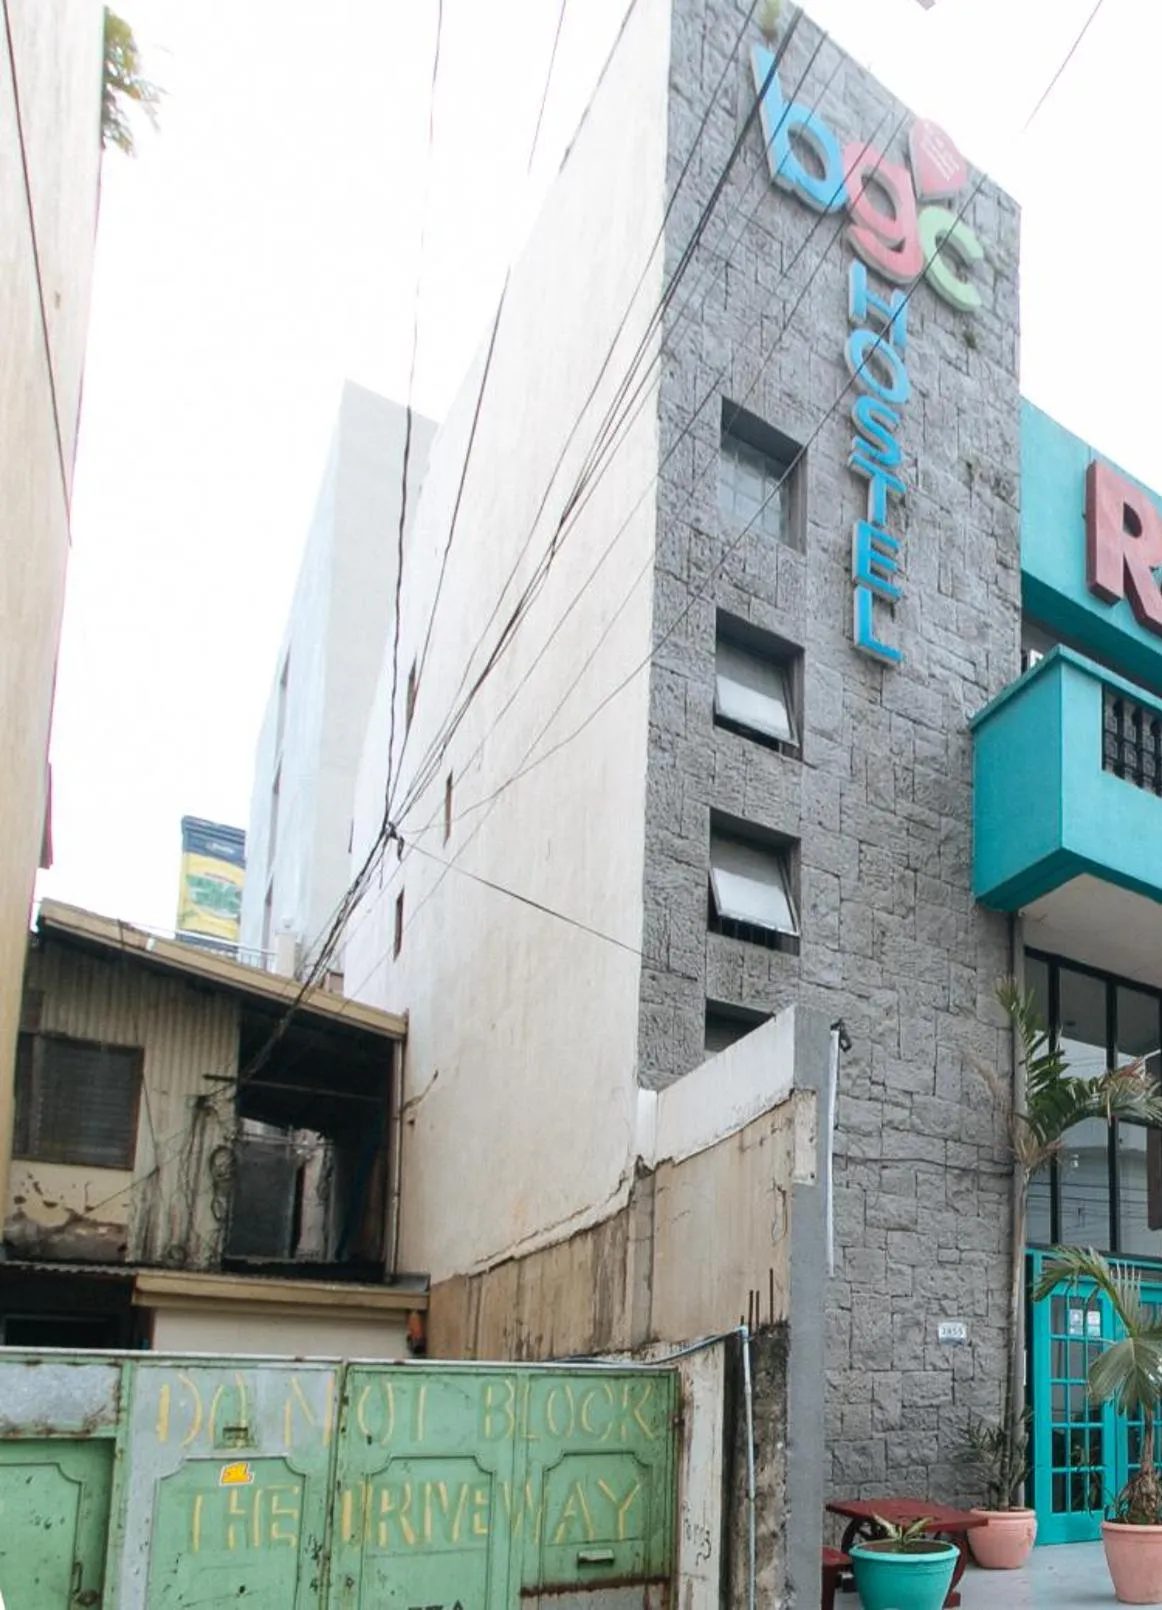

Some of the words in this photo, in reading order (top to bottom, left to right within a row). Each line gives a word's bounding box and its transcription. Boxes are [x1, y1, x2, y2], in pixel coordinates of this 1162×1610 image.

[751, 44, 984, 312] bgc
[846, 257, 911, 667] HOSTEL
[157, 1373, 248, 1449] DO
[284, 1374, 432, 1449] NOT
[484, 1376, 655, 1443] BLOCK
[186, 1484, 300, 1552] THE
